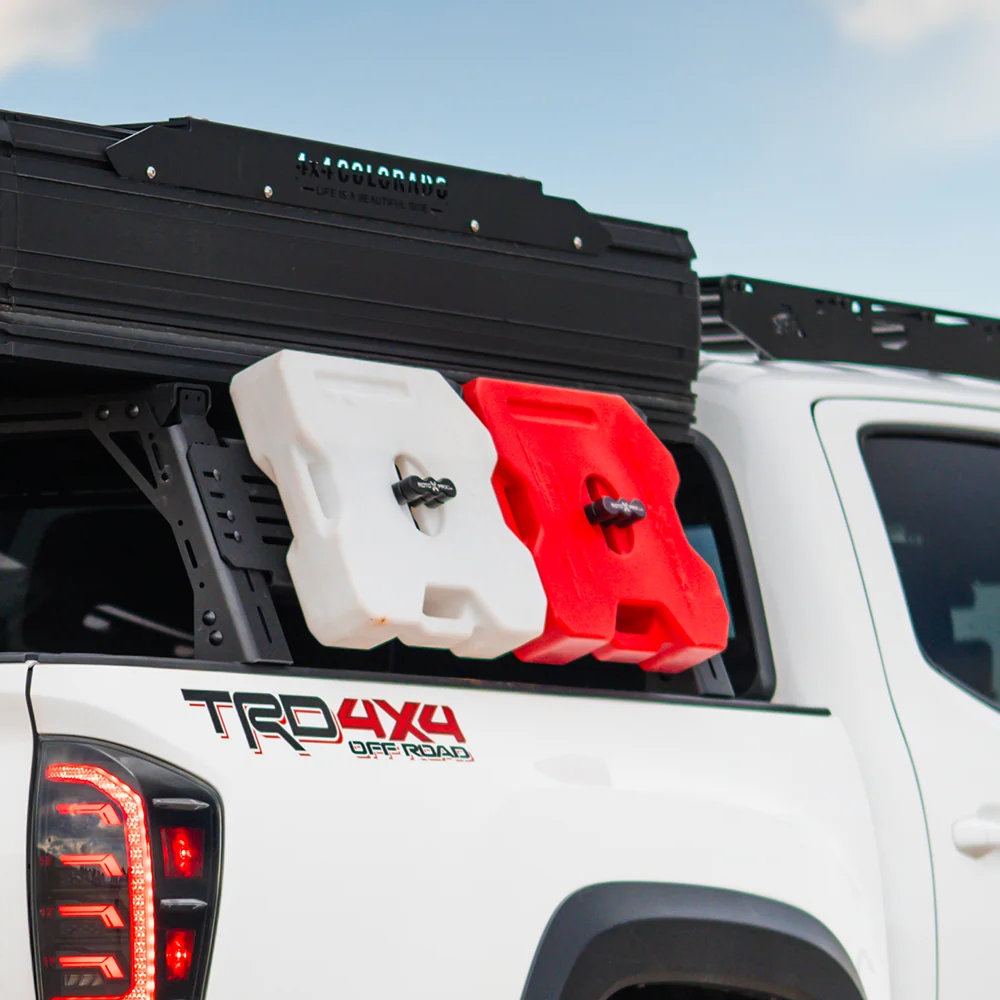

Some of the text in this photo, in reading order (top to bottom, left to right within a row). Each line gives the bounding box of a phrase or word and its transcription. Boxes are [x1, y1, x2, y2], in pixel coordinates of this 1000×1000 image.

[316, 186, 337, 198] LIFE
[181, 689, 341, 755] TRD
[349, 740, 473, 760] OFF ROAD
